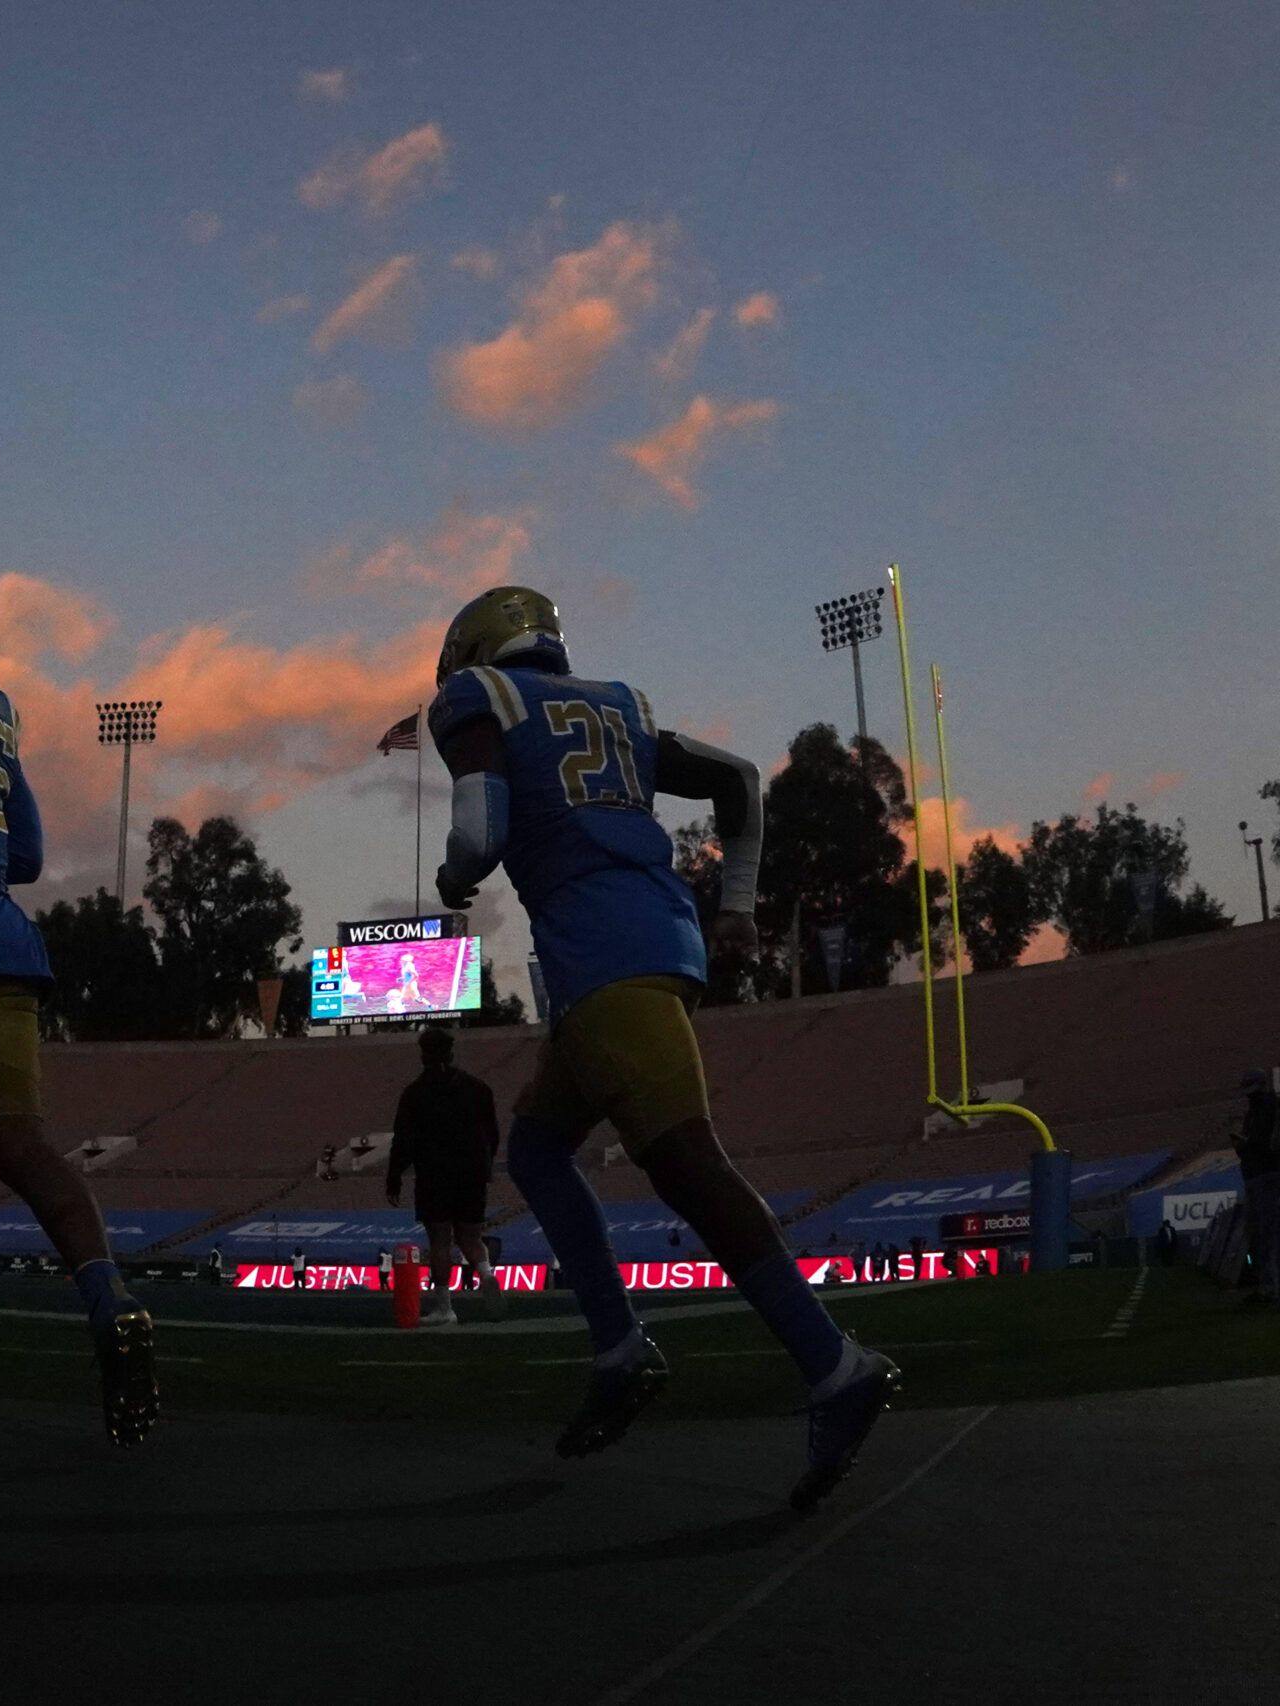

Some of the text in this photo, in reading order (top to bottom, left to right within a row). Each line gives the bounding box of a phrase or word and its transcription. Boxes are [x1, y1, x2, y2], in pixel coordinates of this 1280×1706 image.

[542, 700, 646, 808] 21
[349, 923, 421, 943] WESCOM
[984, 1213, 1031, 1231] redbox
